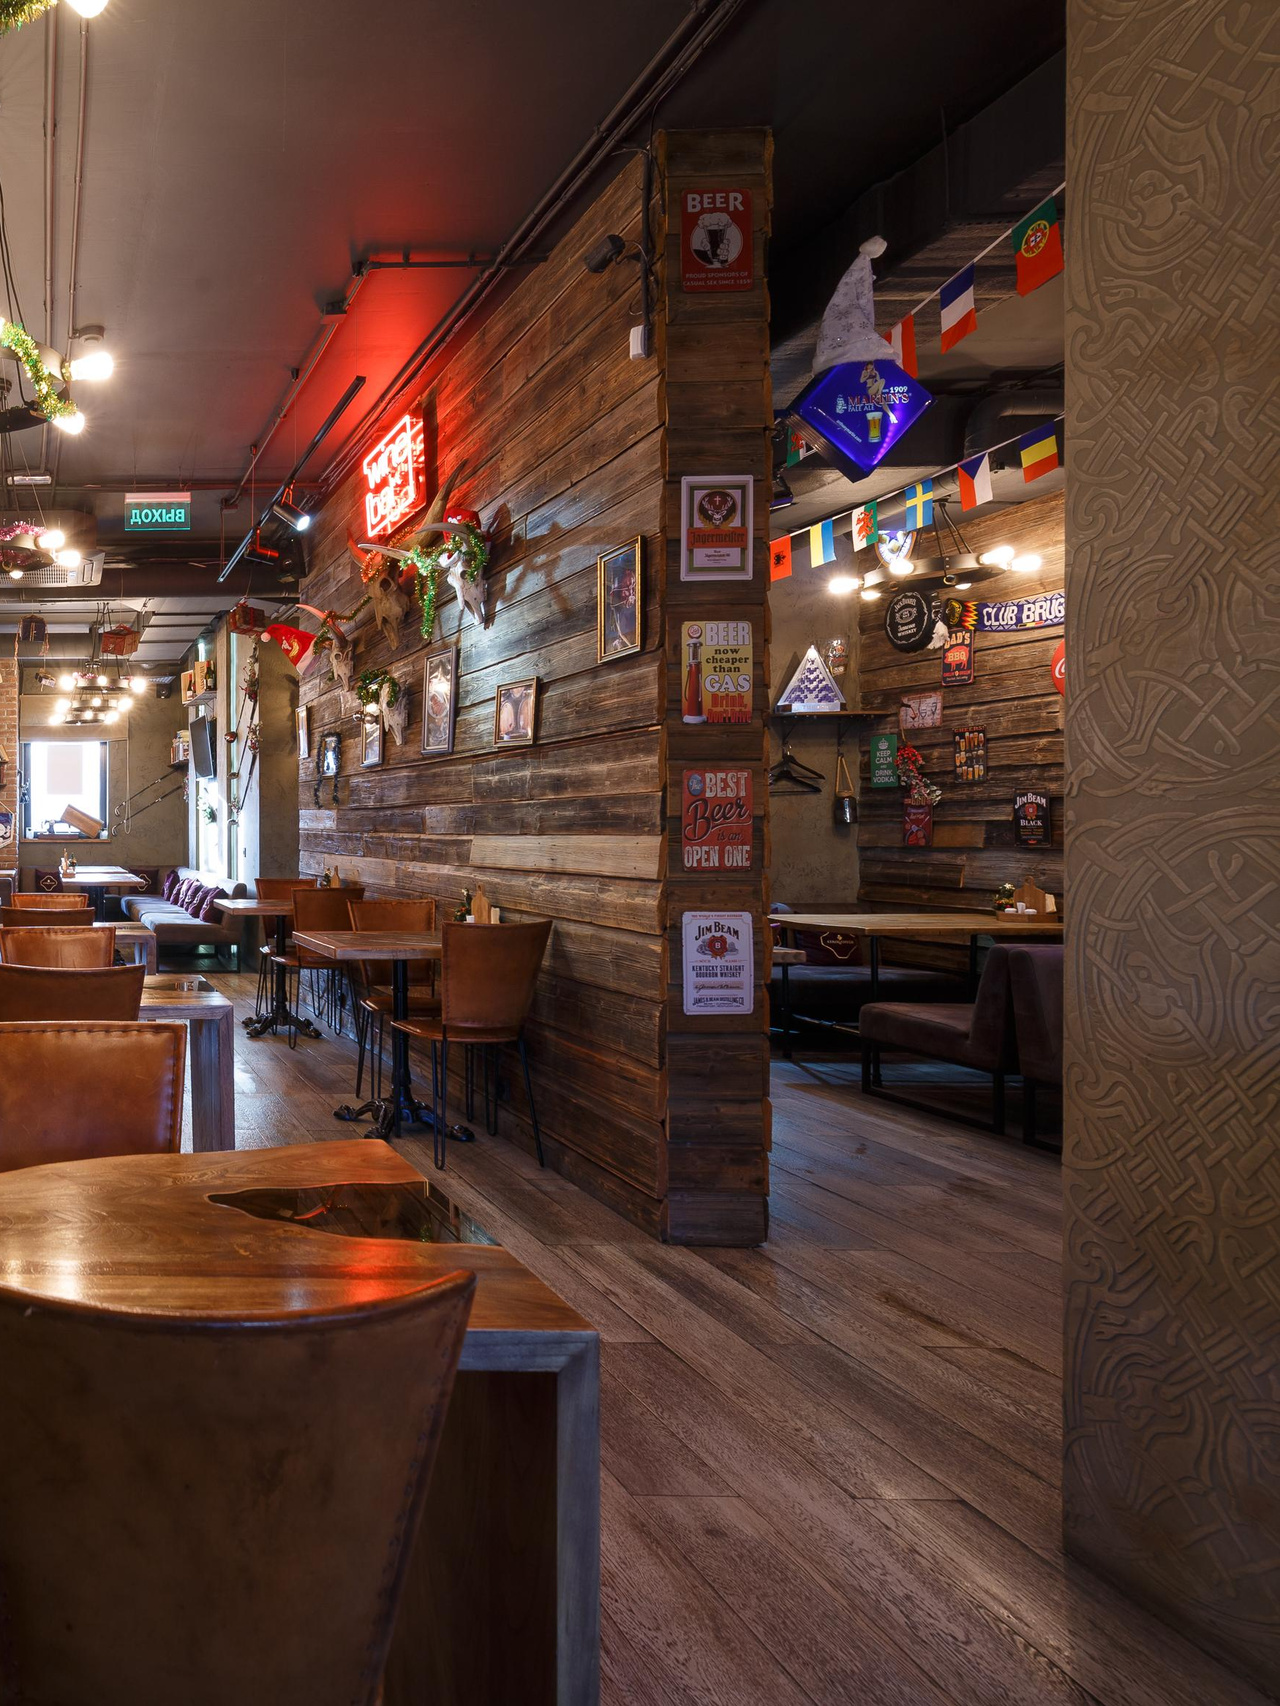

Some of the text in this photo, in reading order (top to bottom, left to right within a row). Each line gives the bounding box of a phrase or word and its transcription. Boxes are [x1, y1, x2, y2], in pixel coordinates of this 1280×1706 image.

[686, 192, 745, 213] BEER
[982, 605, 1018, 626] CLUB
[705, 622, 750, 646] BEER
[706, 655, 749, 665] cheaper
[948, 651, 967, 662] BBQ
[713, 665, 740, 673] than
[704, 674, 751, 693] GAS
[875, 756, 893, 764] CALM
[705, 772, 748, 797] BEST
[1015, 793, 1047, 809] JIM BEAM
[685, 797, 750, 842] Beer
[684, 845, 751, 867] OPEN ONE
[694, 921, 740, 941] JIM BEAM
